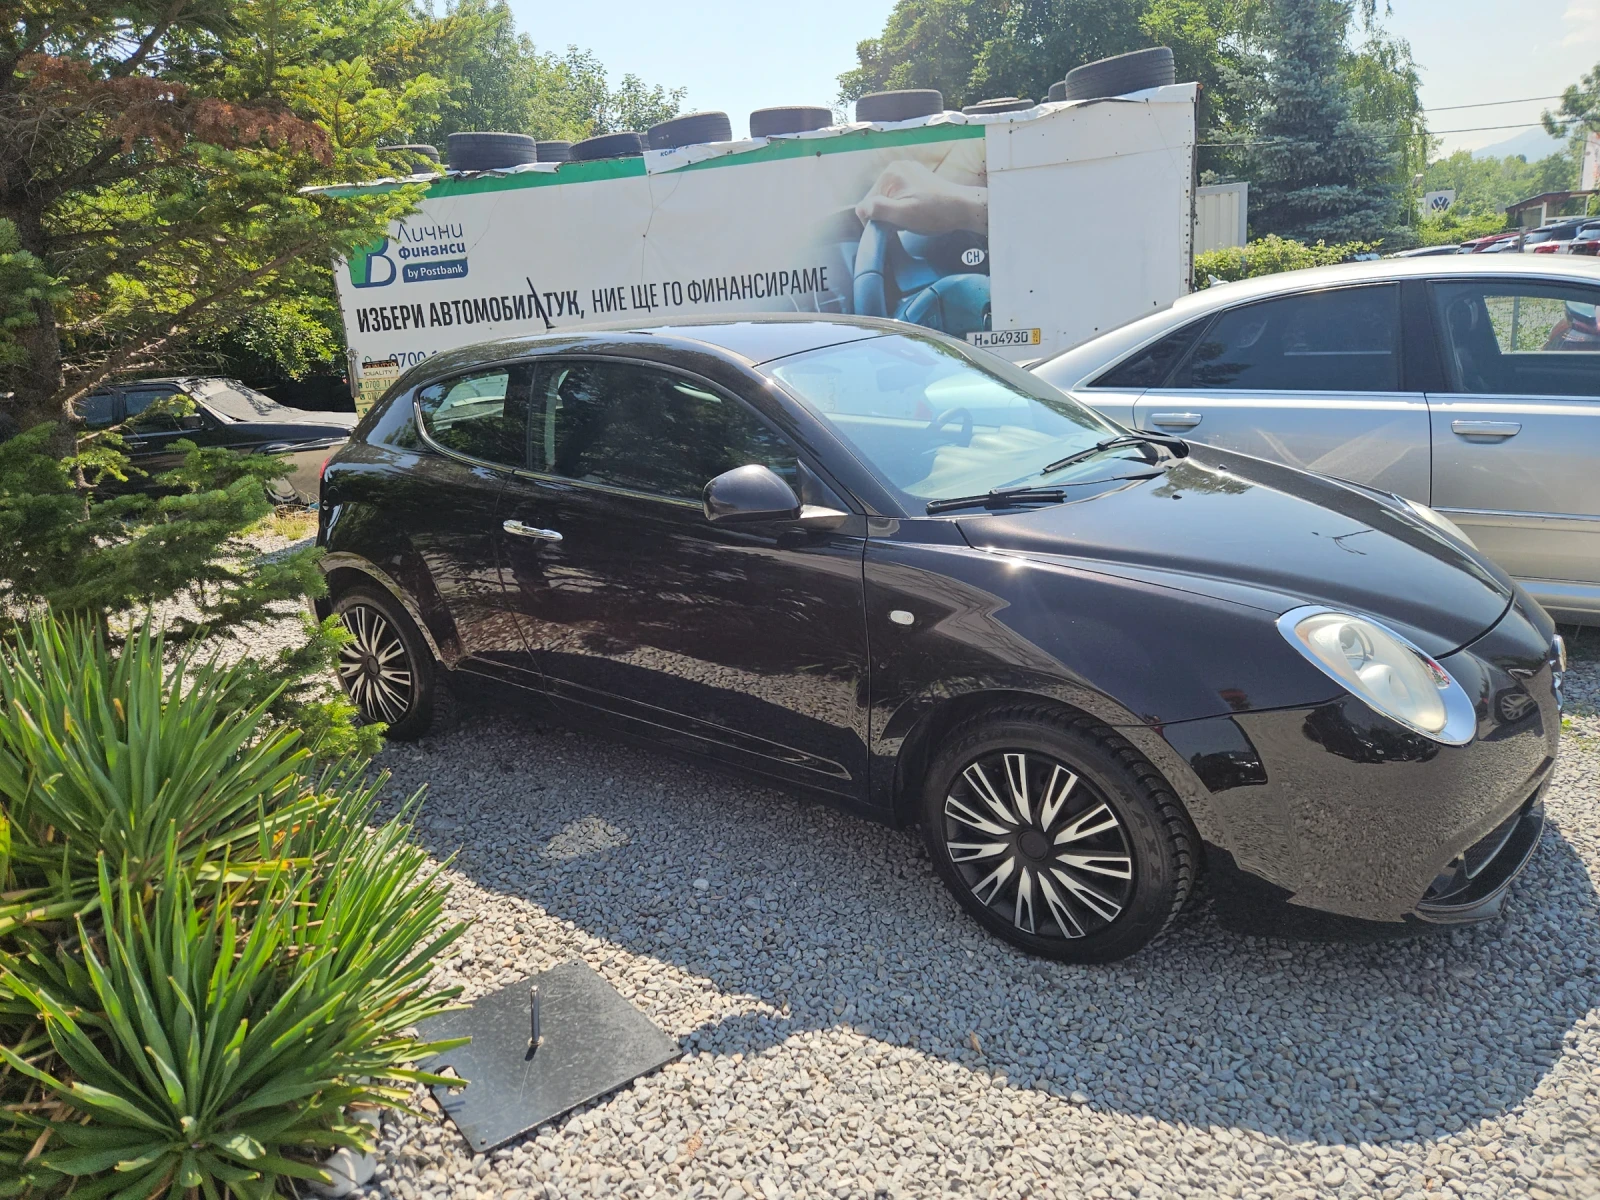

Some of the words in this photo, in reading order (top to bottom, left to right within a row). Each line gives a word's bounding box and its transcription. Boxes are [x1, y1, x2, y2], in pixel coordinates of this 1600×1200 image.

[397, 223, 464, 243] Лични
[966, 250, 980, 264] CH
[407, 268, 419, 279] by
[420, 263, 464, 277] Postbank
[356, 303, 426, 333] ИЗБЕРИ
[430, 294, 541, 327] АВТОМОБИЛ
[543, 290, 585, 319] ТУК,
[591, 286, 628, 313] НИЕ
[630, 283, 658, 313] ЩЕ
[663, 280, 683, 307] ГО
[687, 266, 829, 304] ФИНАНСИРАМЕ
